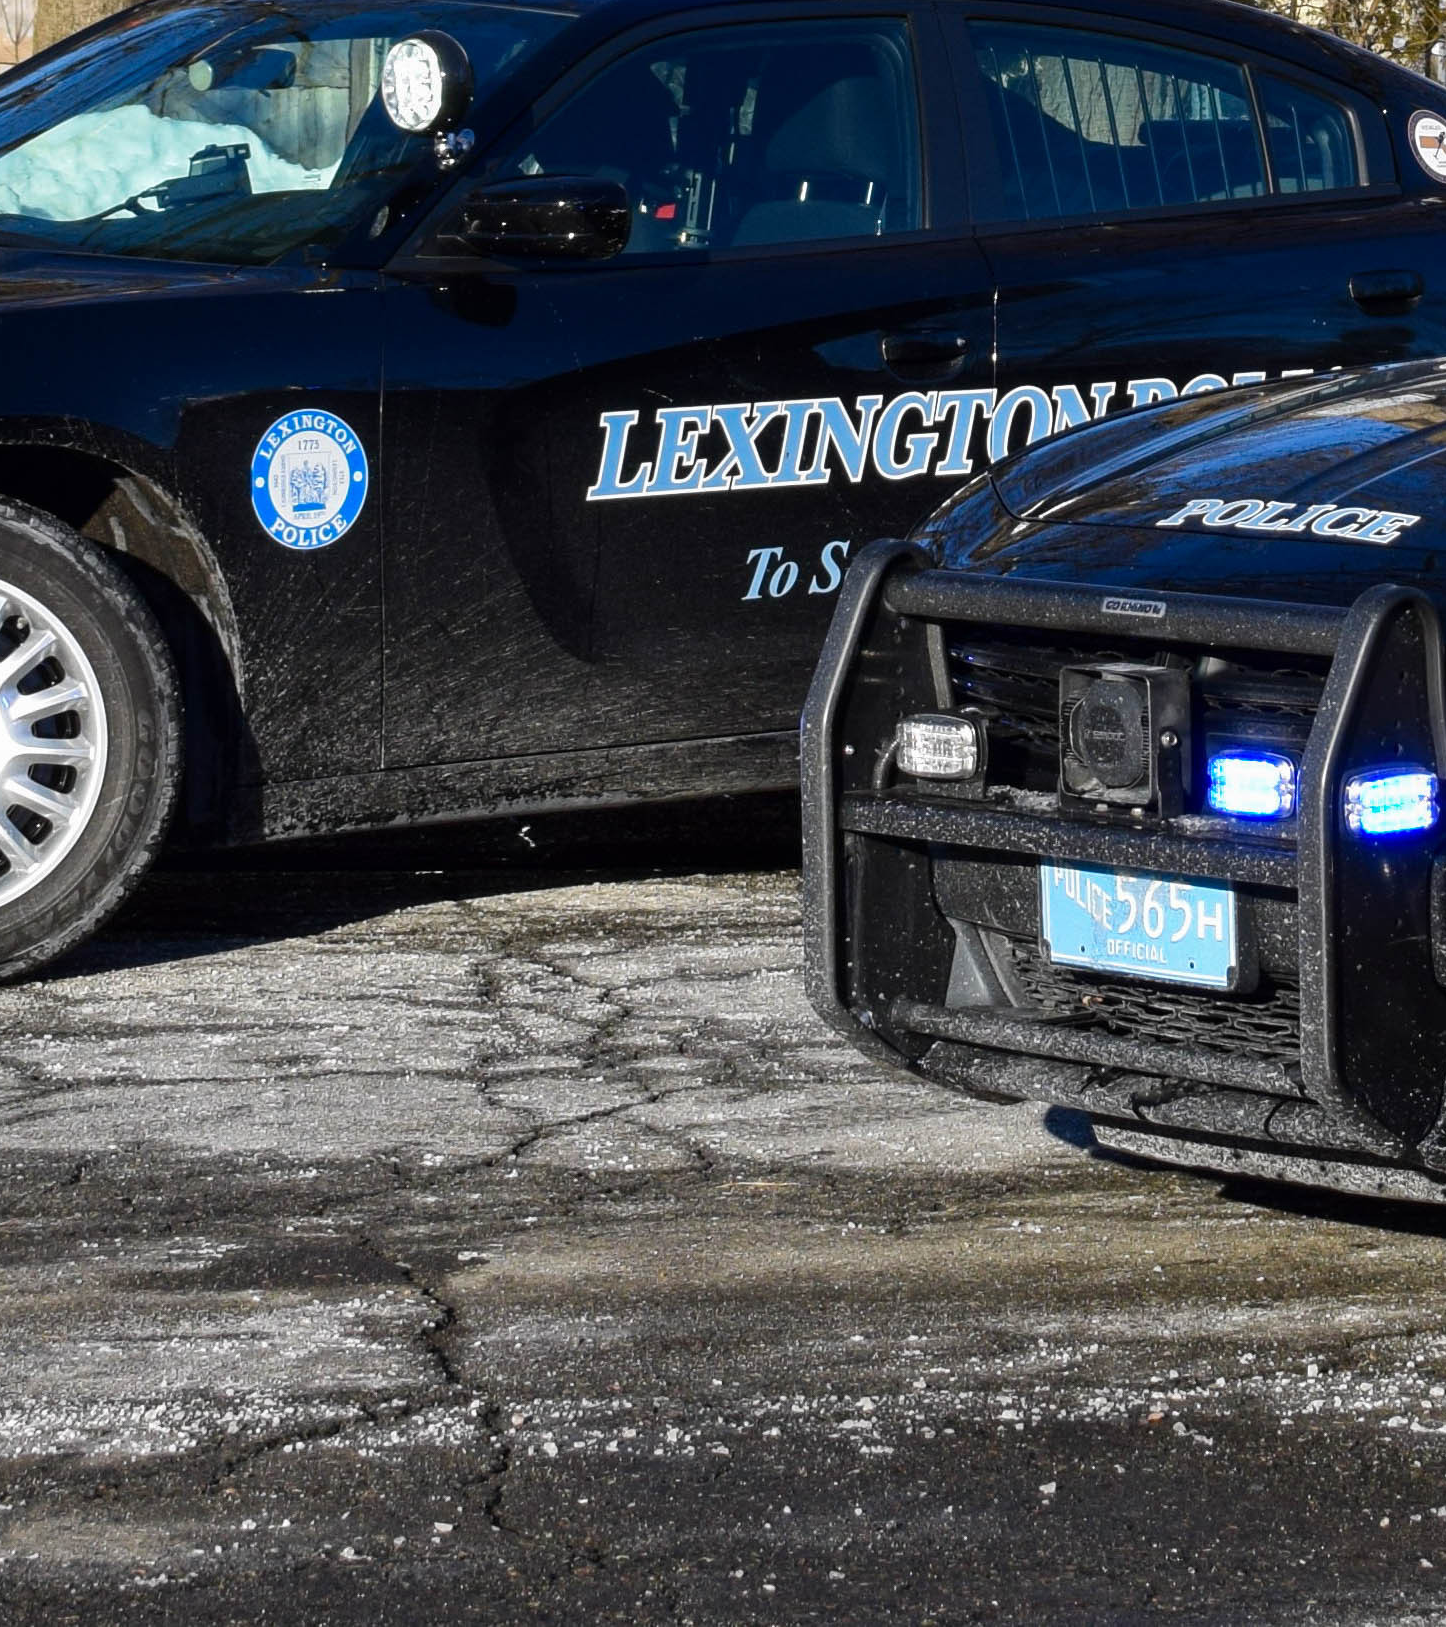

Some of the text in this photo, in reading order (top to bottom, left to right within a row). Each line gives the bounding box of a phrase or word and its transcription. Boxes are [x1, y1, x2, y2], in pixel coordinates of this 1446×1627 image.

[259, 414, 357, 460] LEXINGTON
[298, 439, 320, 451] 1775
[270, 514, 347, 546] POLICE
[1156, 499, 1421, 544] POLICE
[741, 540, 850, 600] To S
[1116, 876, 1225, 943] 565H
[1107, 939, 1167, 964] OFFICIAL
